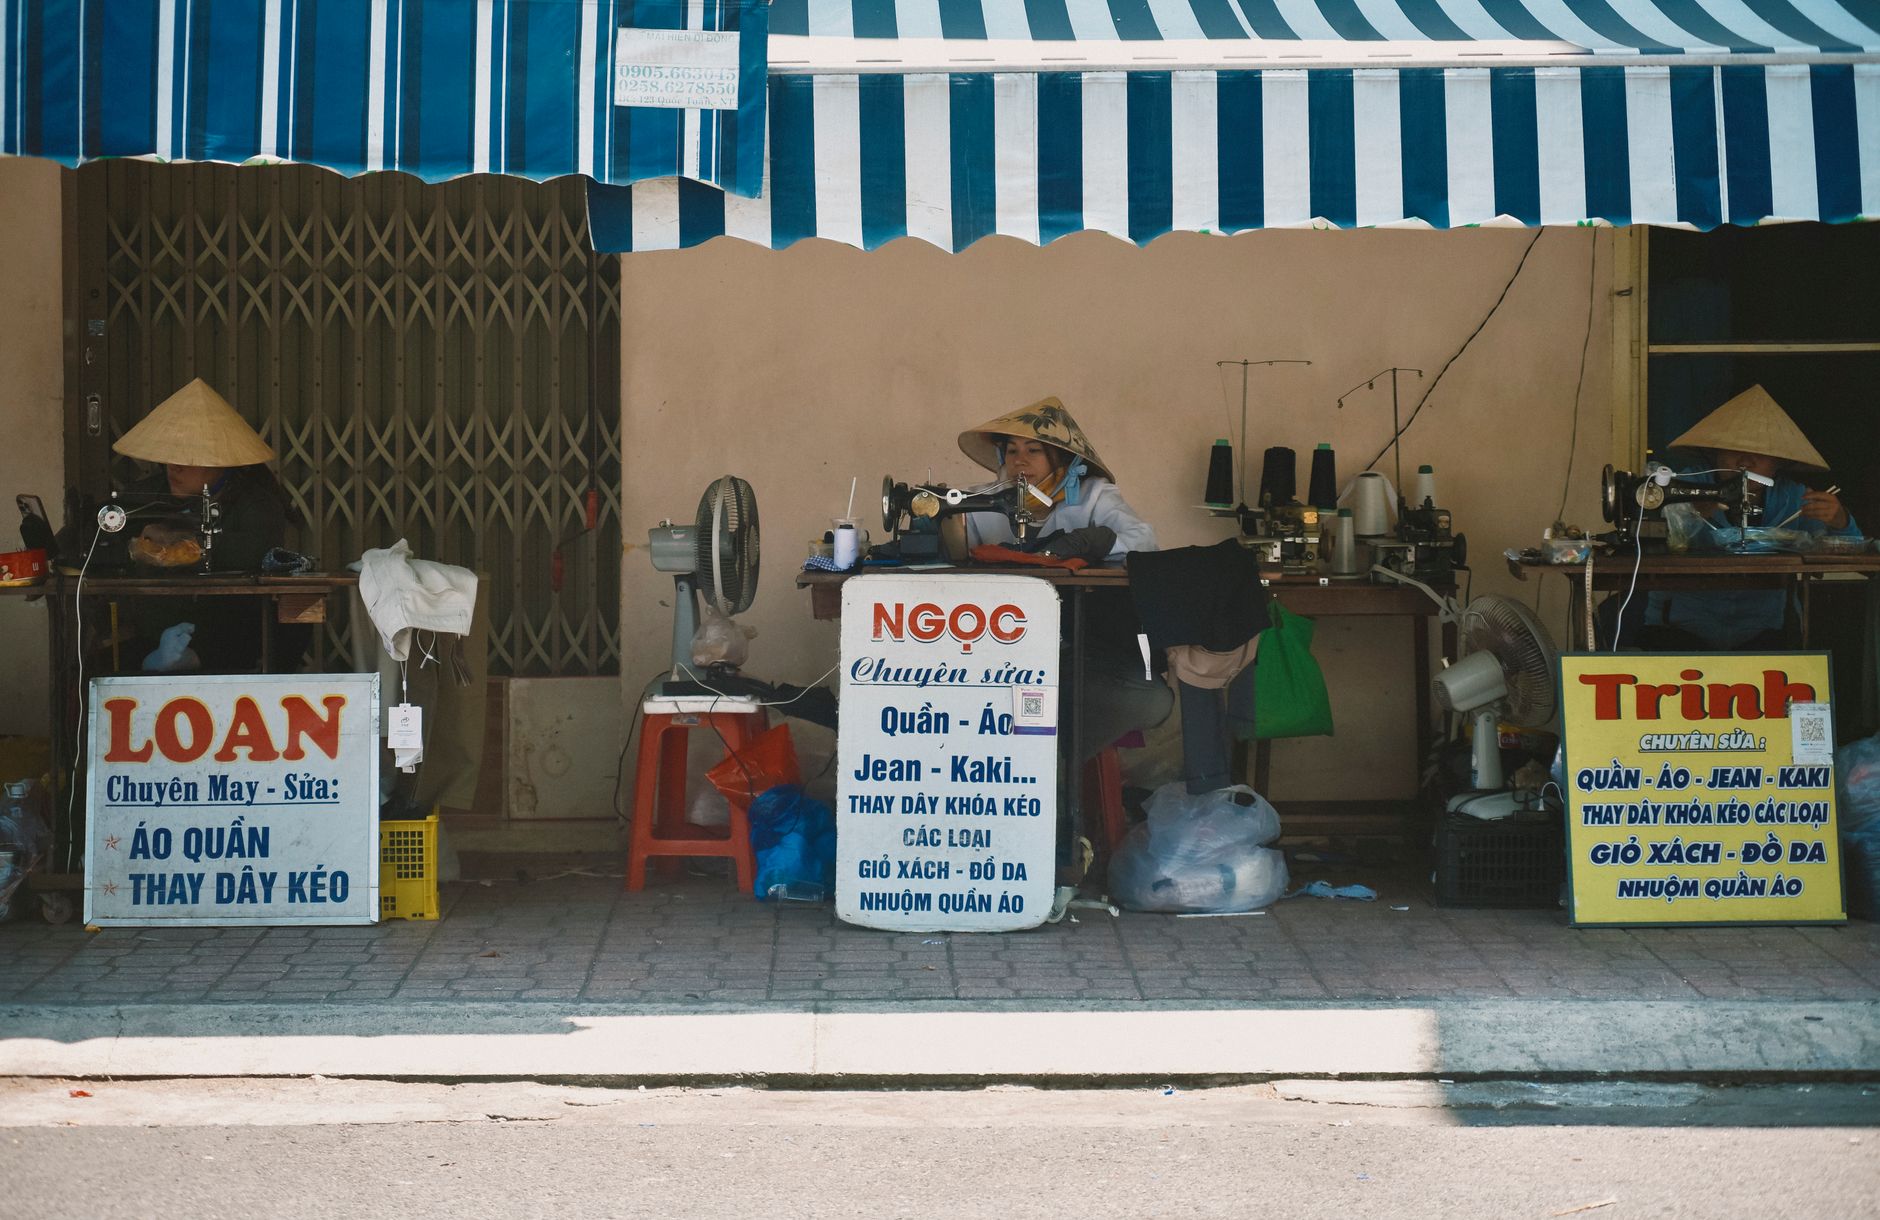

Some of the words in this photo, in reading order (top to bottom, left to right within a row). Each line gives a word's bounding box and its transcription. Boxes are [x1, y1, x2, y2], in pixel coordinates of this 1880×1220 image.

[639, 95, 655, 104] 123
[871, 602, 1028, 655] NGỌC
[850, 656, 970, 688] Chuyên
[980, 662, 1046, 685] sửa:
[1578, 669, 1817, 721] Trinh
[103, 694, 348, 764] LOAN
[881, 702, 949, 737] Quần
[978, 702, 1013, 736] Áo
[1639, 730, 1716, 751] CHUYÊN
[854, 754, 921, 782] Jean
[951, 755, 1037, 784] Kaki...
[1576, 758, 1642, 793] QUẦN
[1656, 762, 1691, 790] ÁO
[1706, 767, 1763, 790] JEAN
[1777, 766, 1832, 788] KAKI
[106, 775, 199, 806] Chuyên
[208, 774, 259, 806] May
[284, 773, 340, 800] Sửa:
[848, 795, 895, 814] THAY
[901, 792, 939, 815] DÂY
[945, 793, 998, 816] KHÓA
[1003, 794, 1041, 817] KÉO
[1582, 804, 1625, 826] THAY
[1627, 799, 1663, 825] DÂY
[1664, 796, 1714, 825] KHÓA
[1716, 797, 1751, 825] KÉO
[1754, 797, 1786, 824] CÁC
[1789, 801, 1830, 830] LOẠI
[129, 821, 172, 860] ÁO
[183, 816, 270, 862] QUẦN
[903, 824, 942, 847] CÁC
[948, 828, 991, 852] LOẠI
[1589, 837, 1642, 866] GIỎ
[1646, 837, 1724, 864] XÁCH
[1740, 832, 1784, 864] ĐỒ
[1788, 841, 1828, 864] DA
[129, 872, 205, 905] THAY
[215, 865, 278, 905] DÂY
[288, 864, 350, 904] KÉO
[858, 854, 891, 879] GIỎ
[897, 857, 950, 880] XÁCH
[969, 856, 996, 881] ĐỒ
[1002, 862, 1028, 881] DA
[859, 889, 932, 916] NHUỘM
[938, 888, 992, 915] QUẦN
[997, 891, 1024, 914] ÁO
[1616, 875, 1700, 904] NHUỘM
[1703, 869, 1767, 901] QUẦN
[1769, 873, 1804, 898] ÁO
